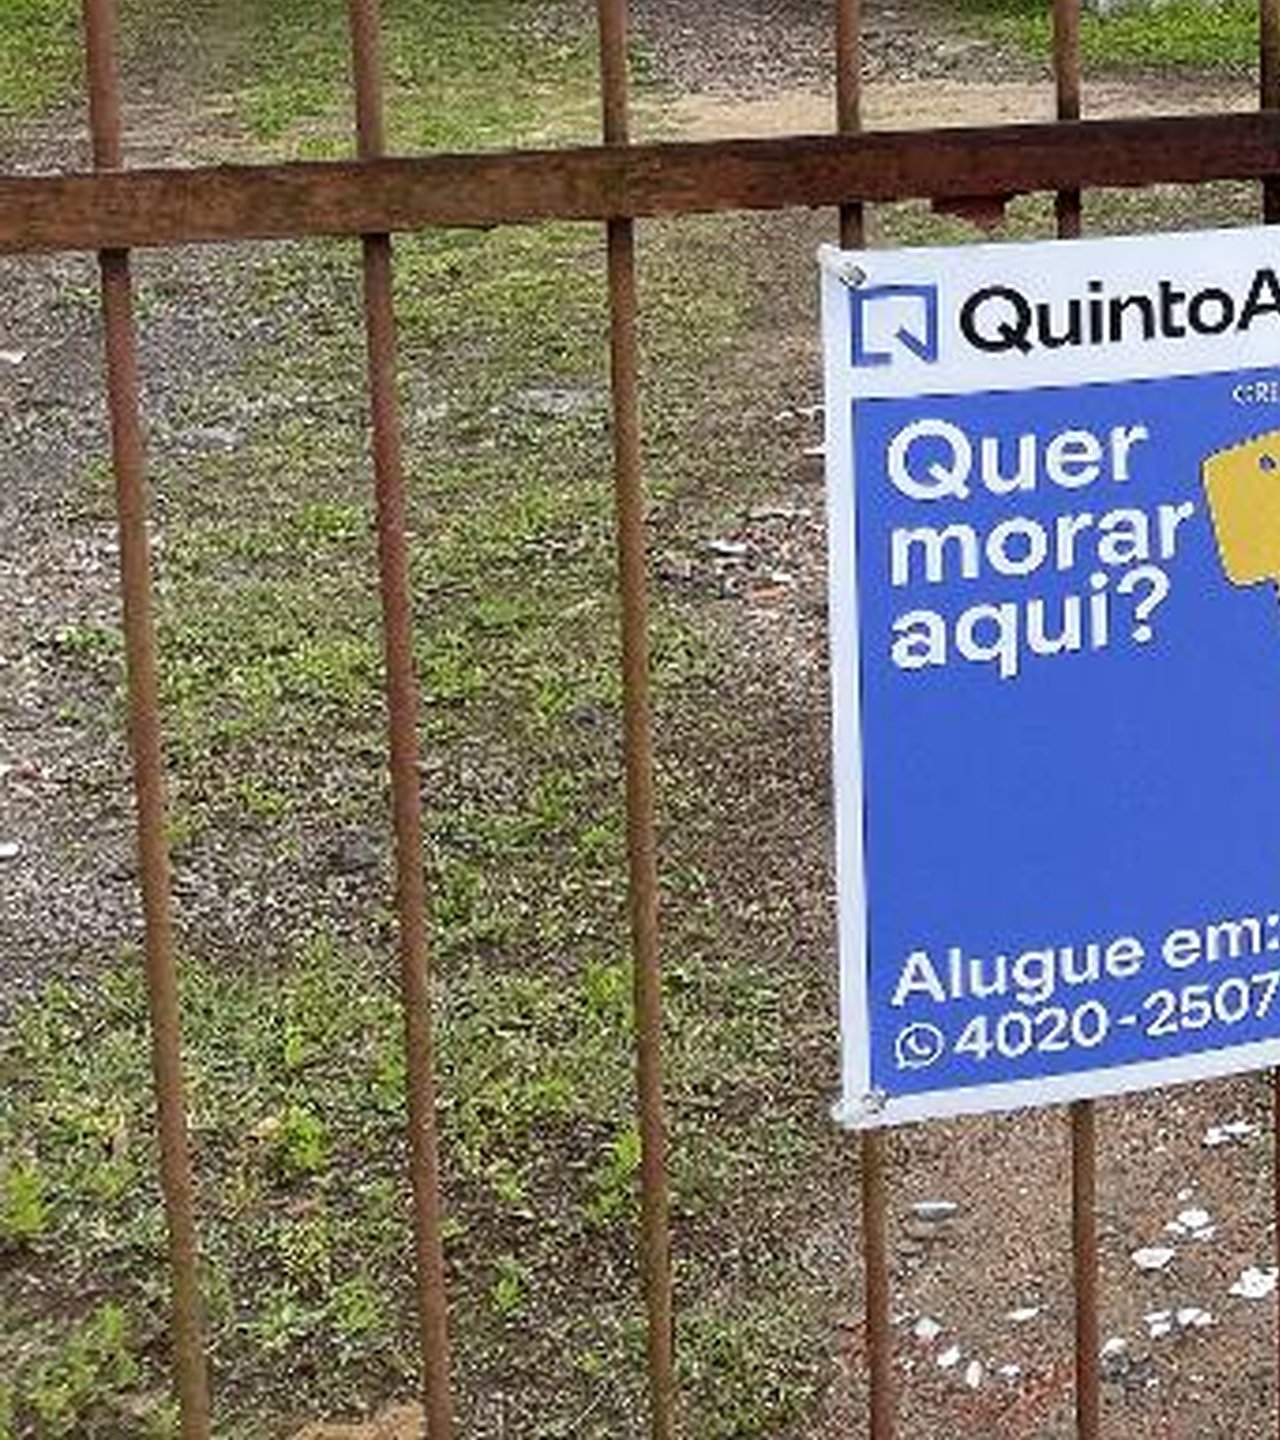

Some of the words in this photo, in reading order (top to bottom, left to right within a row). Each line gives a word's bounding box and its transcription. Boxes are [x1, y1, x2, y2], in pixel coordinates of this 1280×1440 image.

[887, 418, 1149, 502] Quer
[890, 498, 1195, 587] morar
[890, 565, 1171, 680] aqui?
[891, 933, 1145, 1008] Alugue
[1162, 911, 1280, 967] em:
